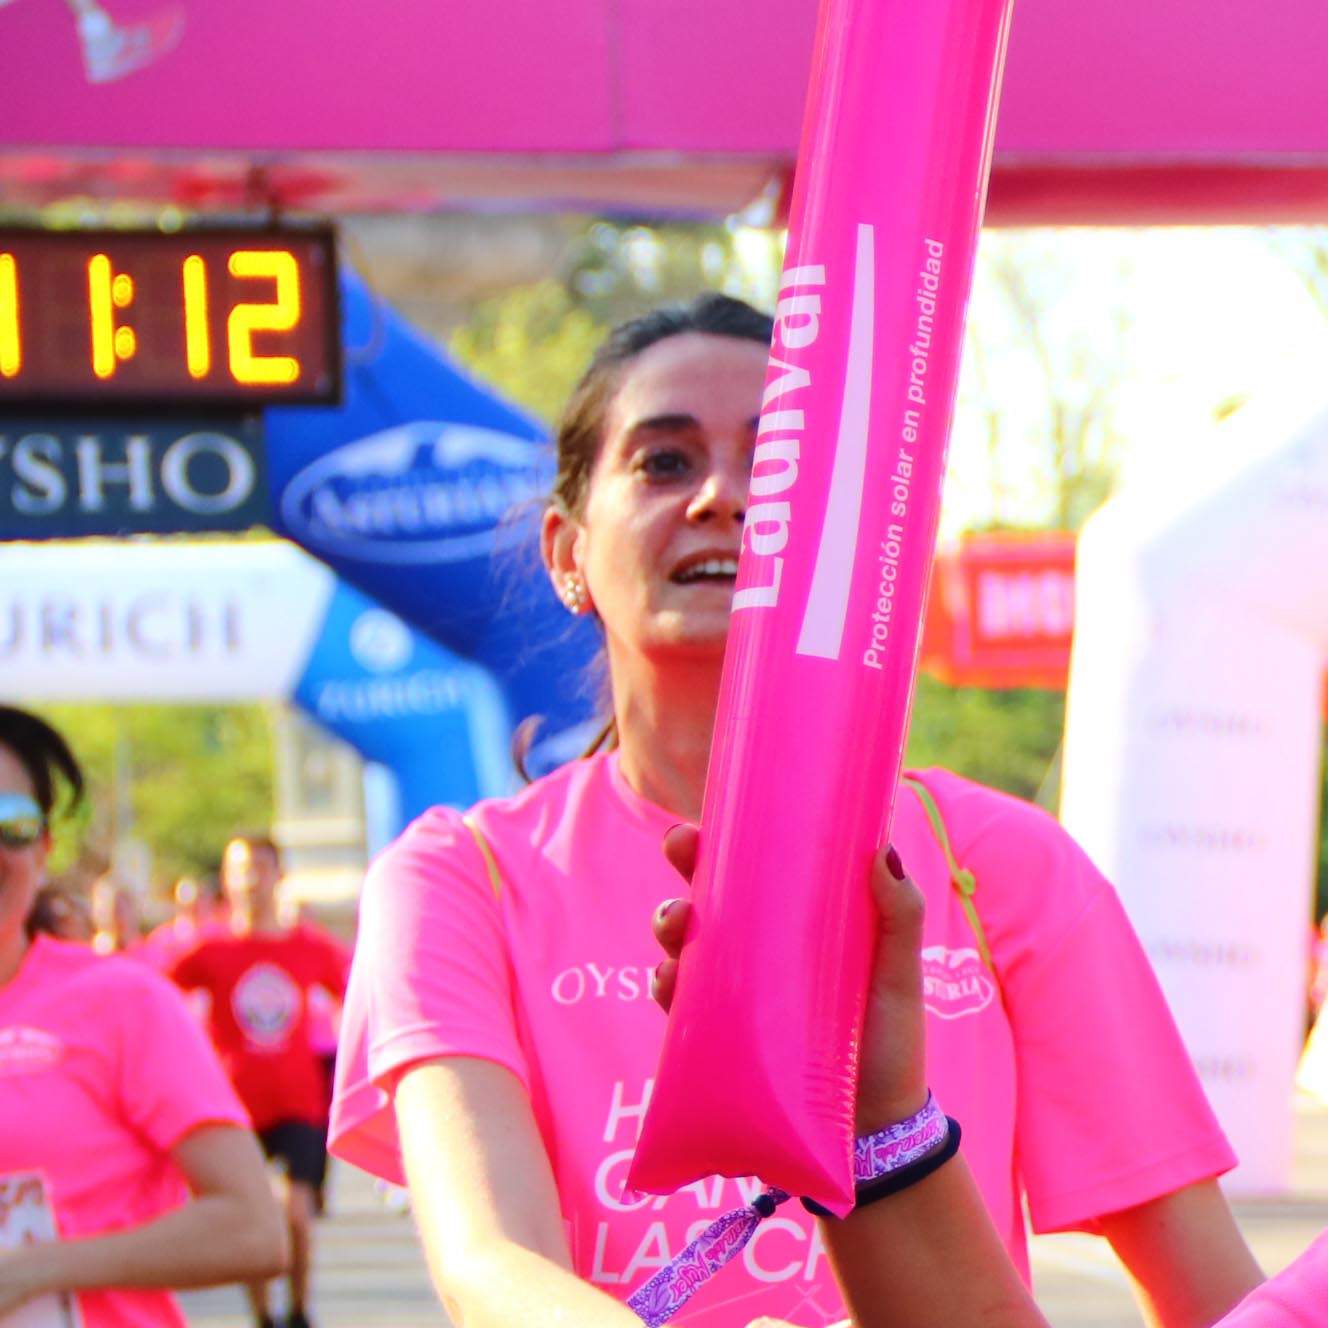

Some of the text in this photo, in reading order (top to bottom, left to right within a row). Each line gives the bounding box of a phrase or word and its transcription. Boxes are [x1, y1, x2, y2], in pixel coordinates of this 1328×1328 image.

[0, 432, 256, 515] SHO
[862, 238, 944, 670] Protección solar en profundidad
